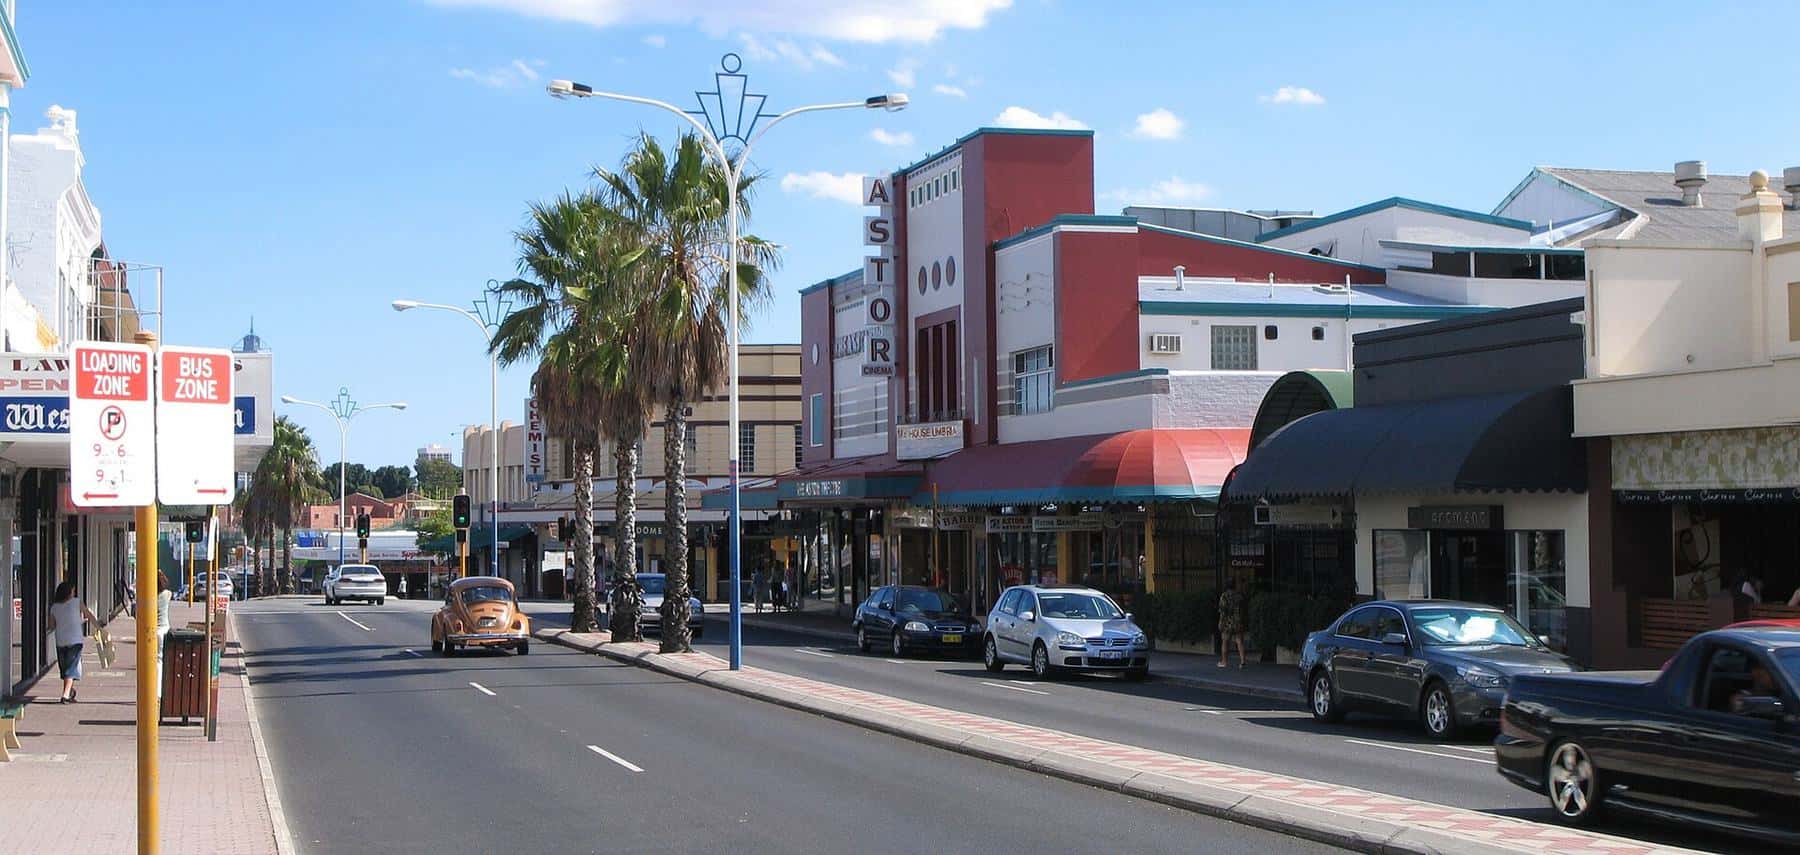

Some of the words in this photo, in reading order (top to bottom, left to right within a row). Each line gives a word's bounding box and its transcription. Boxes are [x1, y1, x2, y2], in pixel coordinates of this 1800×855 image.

[868, 178, 891, 362] ASTOR
[12, 359, 70, 371] LAW
[82, 351, 141, 374] LOADING
[179, 357, 213, 377] BUS
[863, 364, 892, 375] CINEMA
[93, 375, 131, 396] ZONE
[175, 378, 218, 400] ZONE
[528, 400, 542, 474] CHEMIST
[636, 526, 663, 535] DOME
